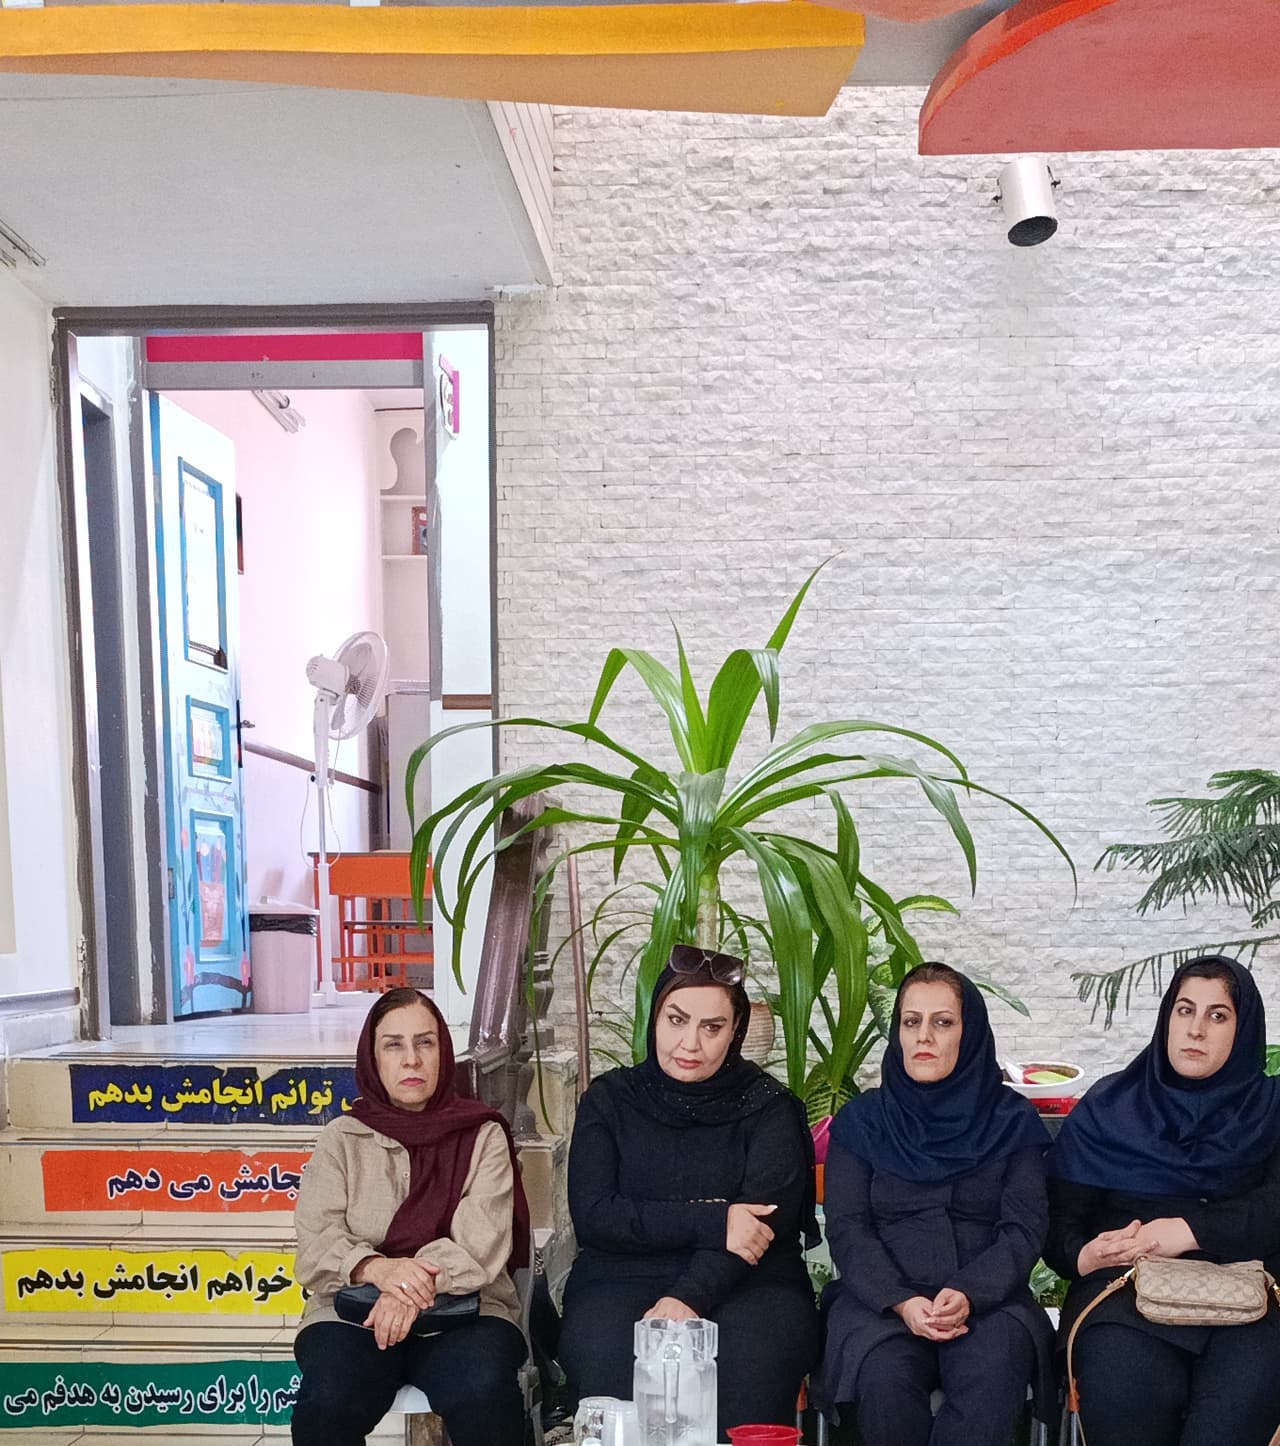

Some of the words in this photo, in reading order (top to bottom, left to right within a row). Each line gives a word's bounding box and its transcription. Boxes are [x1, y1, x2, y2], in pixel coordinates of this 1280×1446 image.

[87, 1082, 154, 1112] بدهم
[161, 1077, 264, 1113] انجامش
[271, 1078, 333, 1115] توانم
[106, 1168, 162, 1200] دهم
[169, 1174, 212, 1200] می
[17, 1267, 85, 1298] بدهم
[93, 1263, 199, 1299] انجامش
[206, 1265, 293, 1301] خواهم
[4, 1387, 39, 1416] می
[42, 1374, 97, 1416] هدفم
[99, 1382, 121, 1414] به
[124, 1381, 195, 1415] رسیدن
[197, 1374, 246, 1414] برای
[248, 1374, 271, 1414] را
